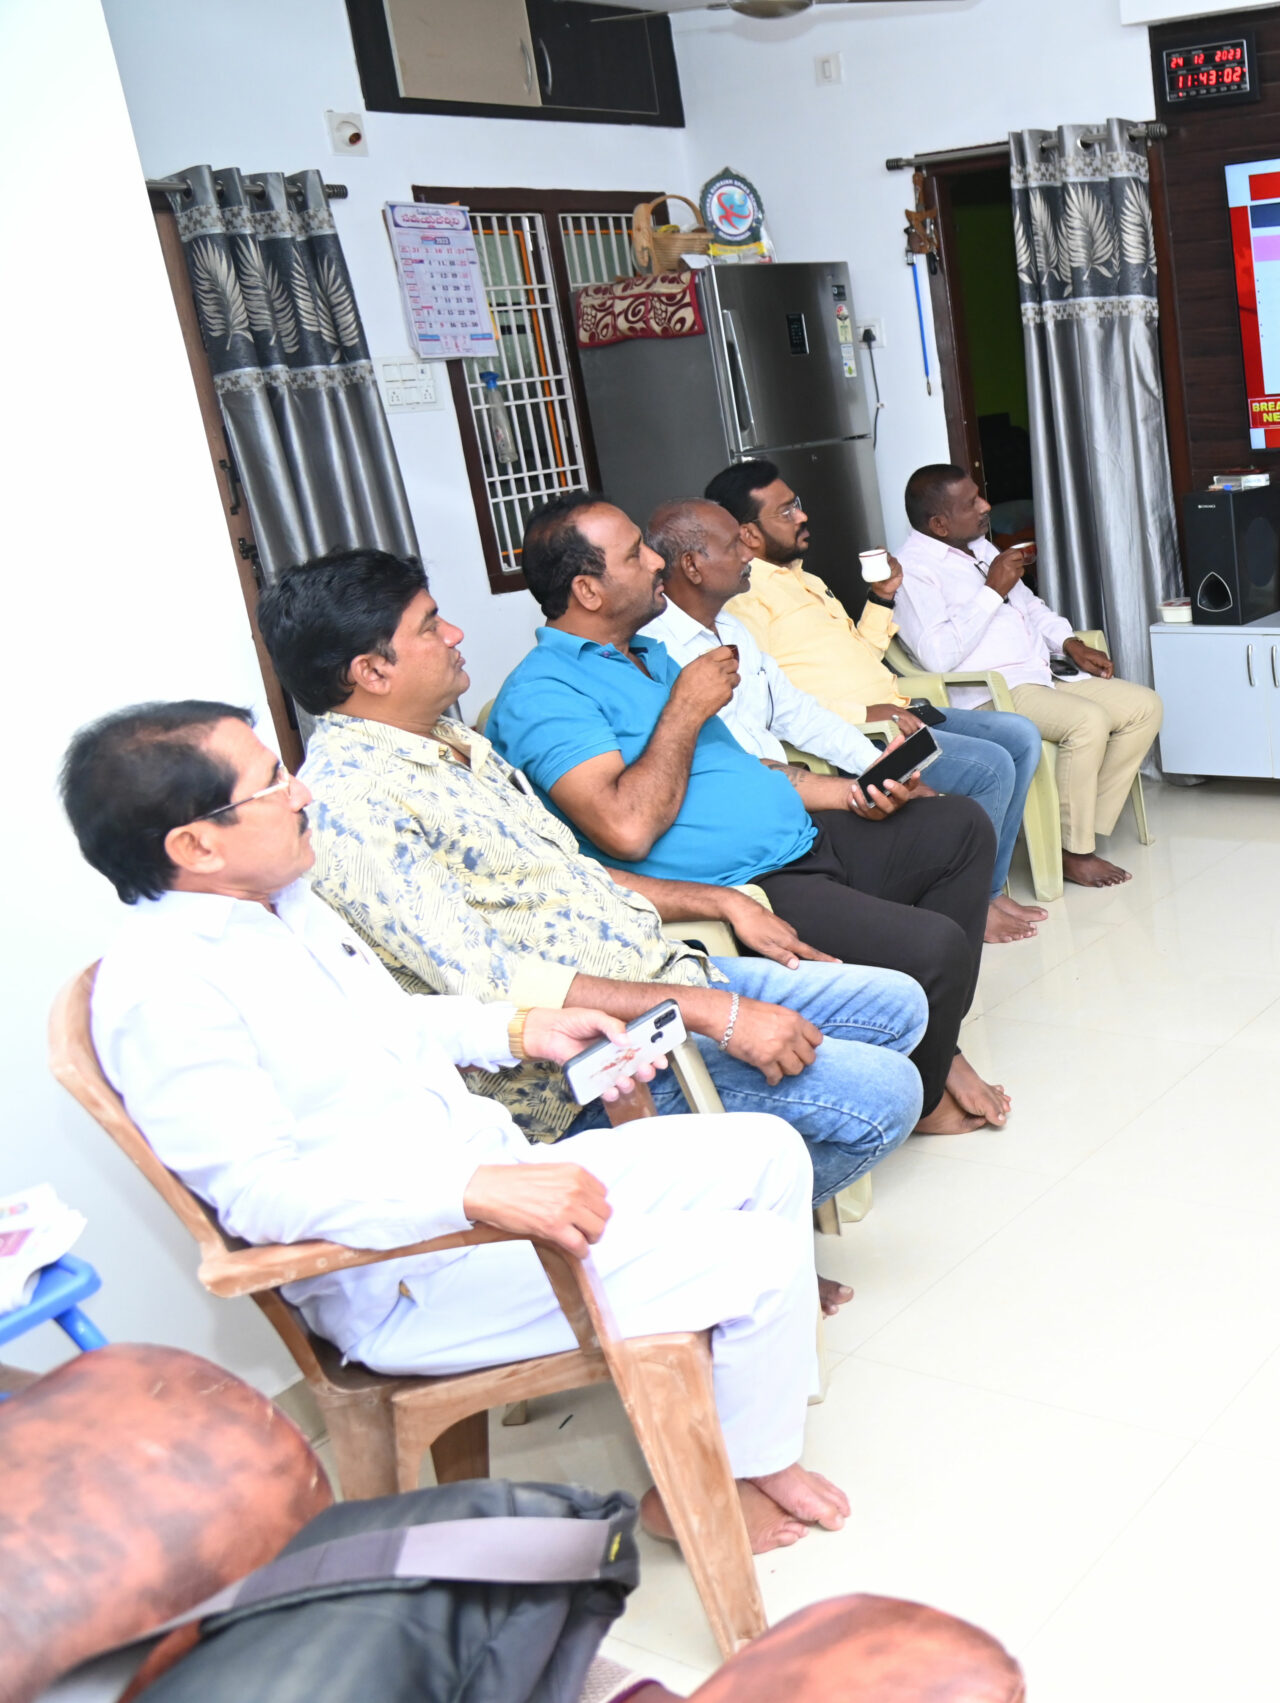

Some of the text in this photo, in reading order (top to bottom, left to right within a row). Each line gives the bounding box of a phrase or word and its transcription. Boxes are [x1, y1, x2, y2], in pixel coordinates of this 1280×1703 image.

[1170, 57, 1184, 69] 24
[1193, 53, 1205, 65] 12
[1214, 47, 1242, 63] 2023
[1178, 66, 1242, 89] 11:43:02
